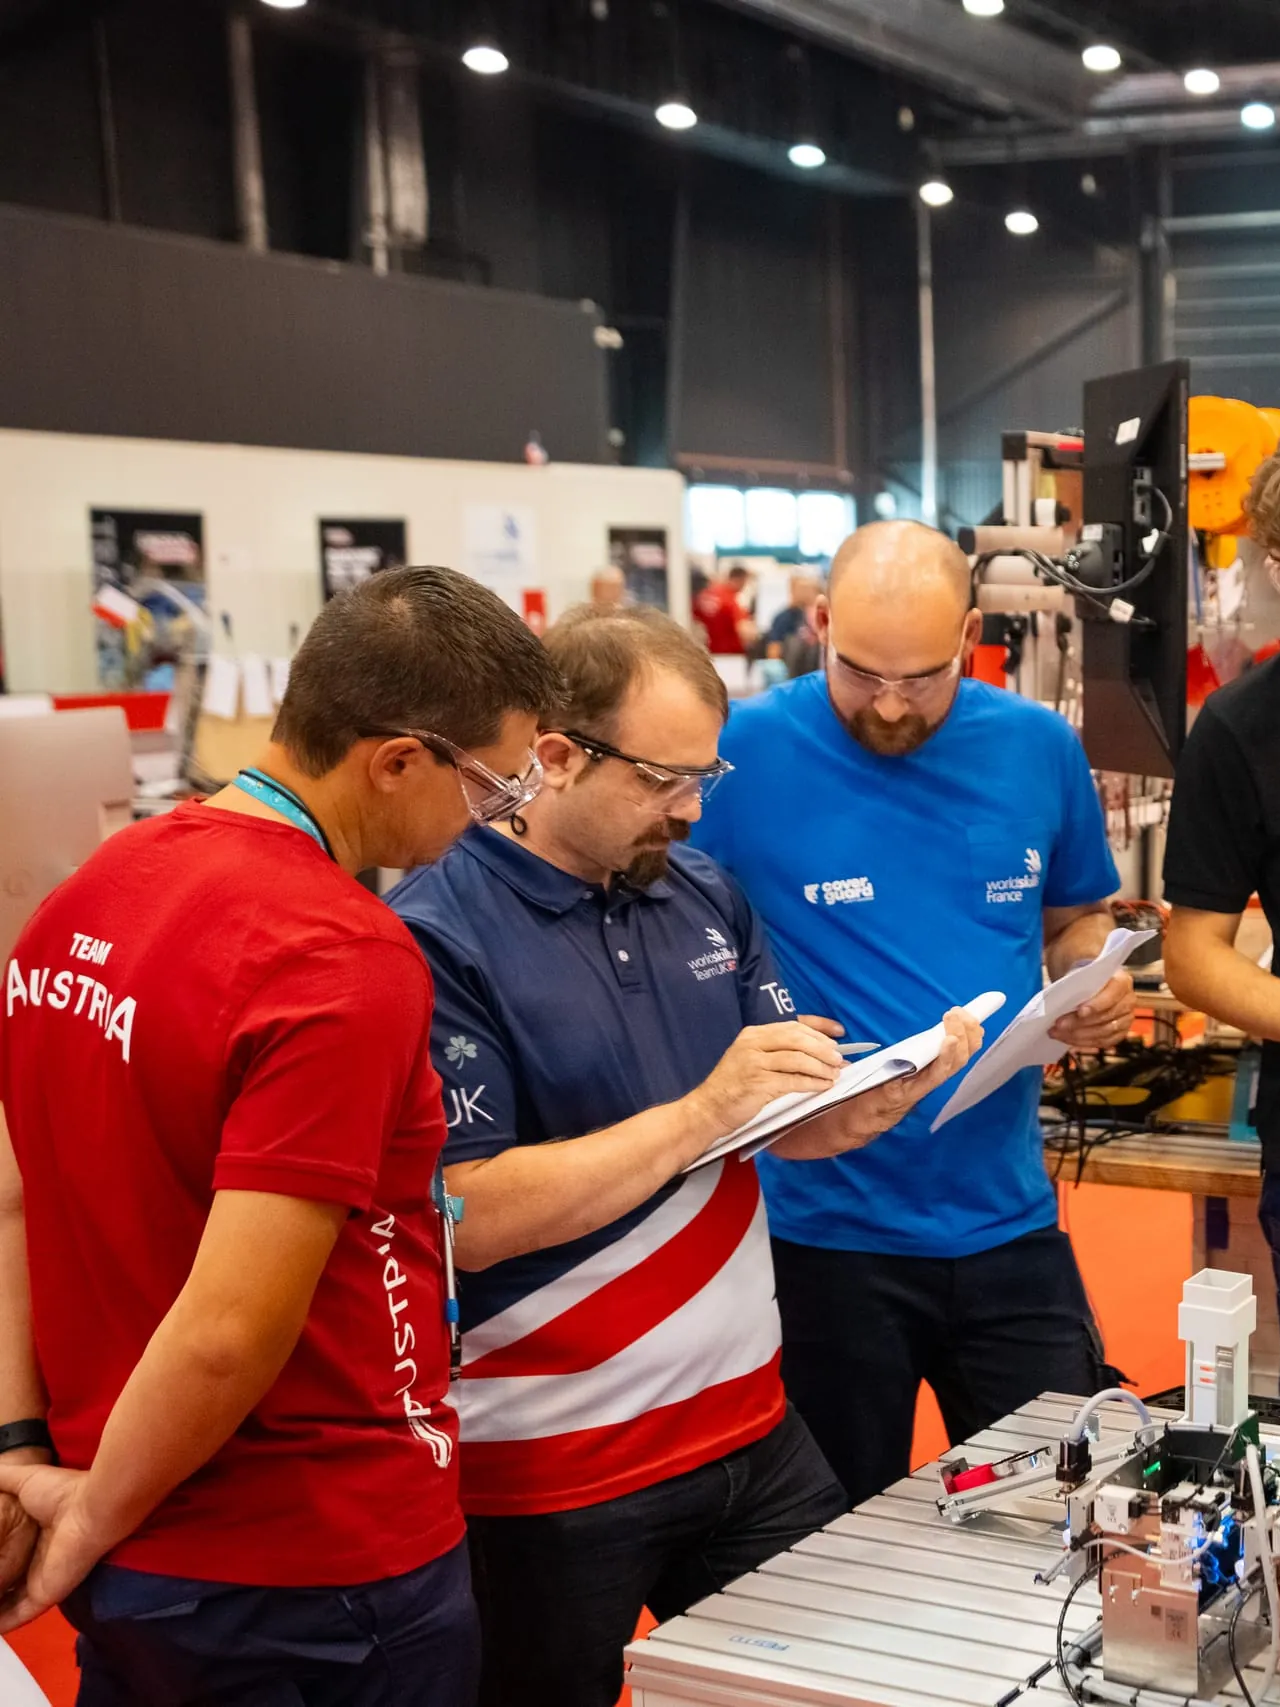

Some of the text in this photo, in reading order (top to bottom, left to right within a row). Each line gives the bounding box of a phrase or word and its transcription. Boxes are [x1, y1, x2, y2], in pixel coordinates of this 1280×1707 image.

[823, 882, 874, 906] guard
[986, 890, 1023, 903] France
[69, 932, 113, 966] TEAM
[6, 958, 137, 1064] AUSTRIA
